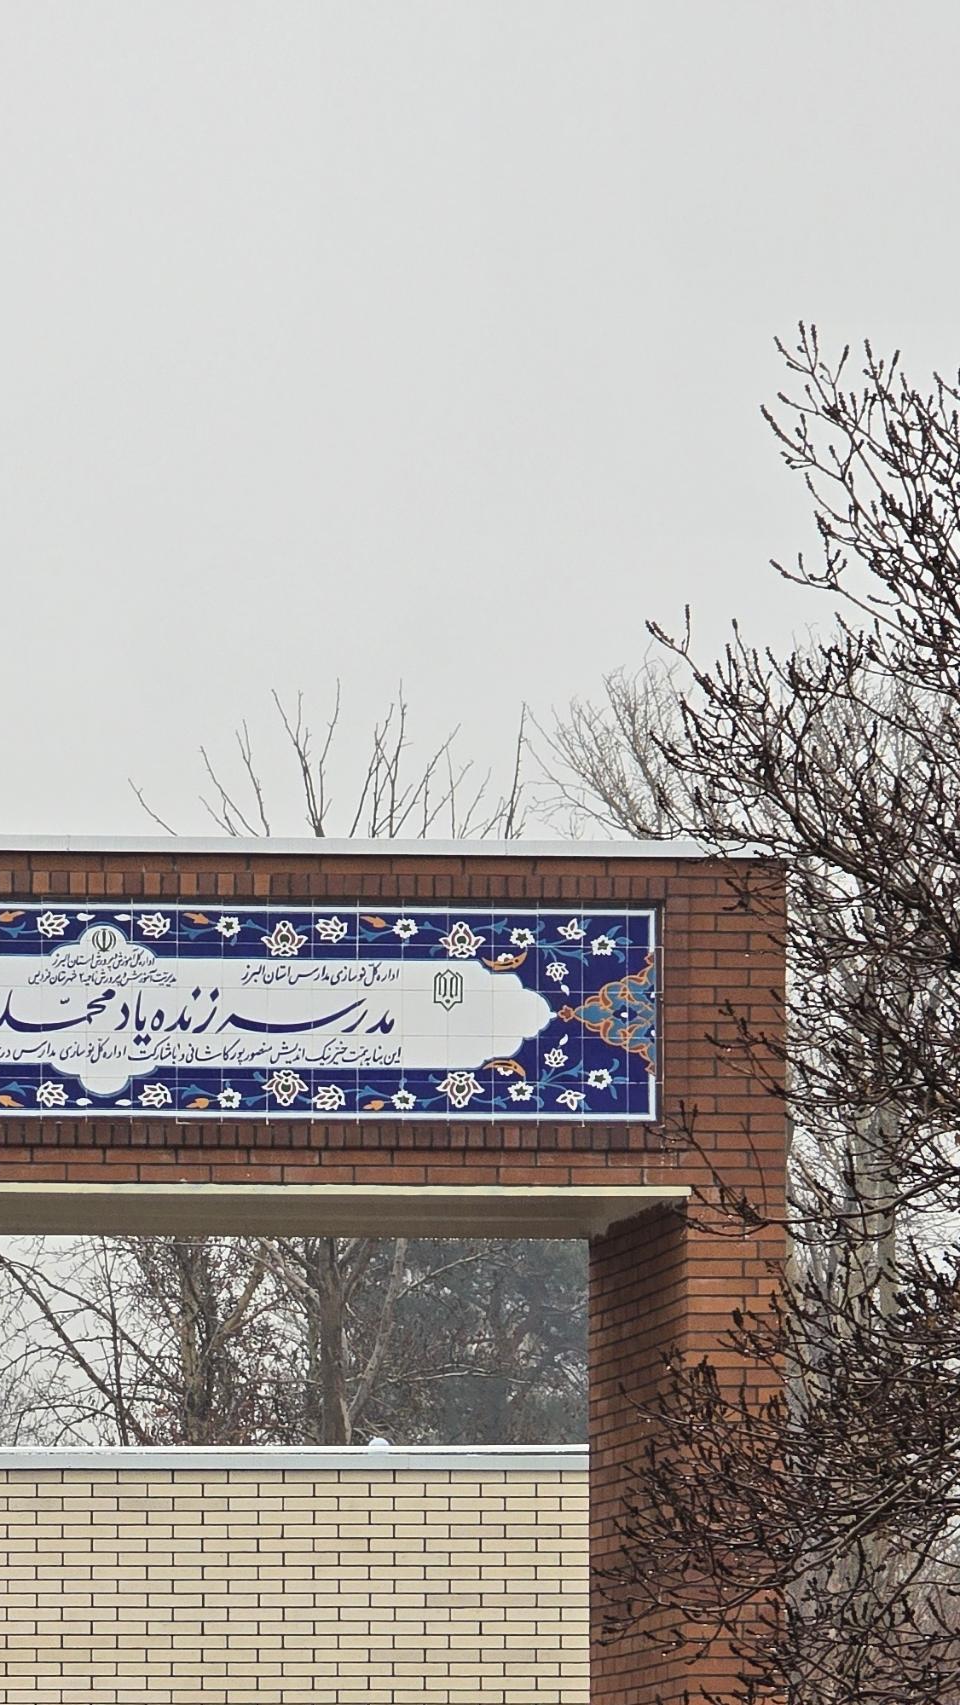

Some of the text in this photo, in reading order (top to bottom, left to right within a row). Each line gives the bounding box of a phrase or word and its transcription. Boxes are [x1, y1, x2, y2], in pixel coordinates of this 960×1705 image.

[52, 952, 70, 968] البرز
[67, 953, 95, 968] استان
[241, 964, 266, 986] البرز
[263, 965, 291, 985] استان
[288, 965, 330, 985] مدارس
[115, 989, 152, 1046] یاد
[151, 985, 221, 1034] زنده
[215, 997, 395, 1034] مدرسه
[0, 1047, 11, 1059] در
[13, 1040, 56, 1061] مدارس
[186, 1038, 240, 1063] کاشانی
[243, 1042, 273, 1062] منصور
[270, 1041, 305, 1064] اندیش
[305, 1038, 337, 1066] نیک
[383, 1045, 401, 1065] این
